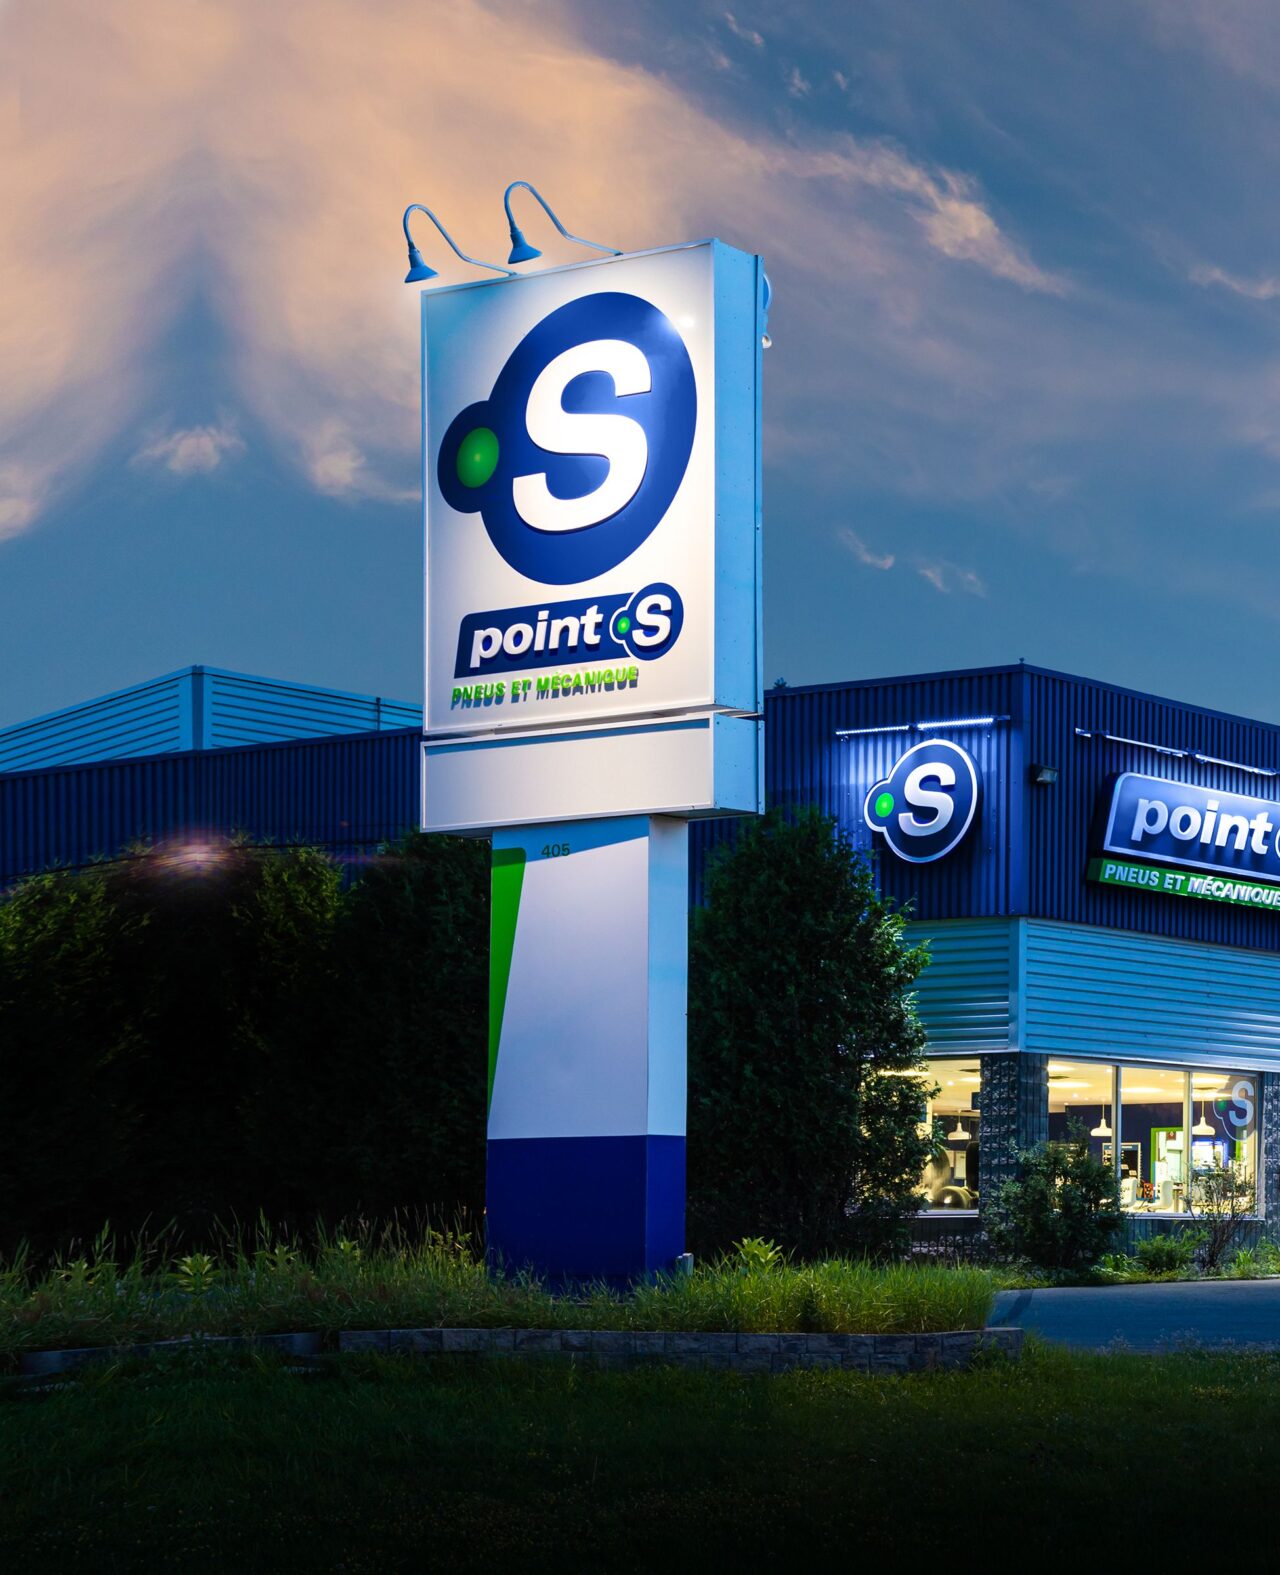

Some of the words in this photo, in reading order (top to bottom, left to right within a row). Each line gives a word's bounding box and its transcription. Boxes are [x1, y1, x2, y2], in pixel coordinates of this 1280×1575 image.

[512, 338, 652, 532] S
[469, 604, 604, 669] point
[631, 593, 673, 648] S
[451, 682, 506, 703] PNEUS
[511, 679, 531, 696] ET
[536, 664, 639, 693] MÉCANIQUE
[898, 761, 956, 837] S
[541, 843, 570, 858] 405
[1130, 798, 1274, 855] point
[1104, 863, 1159, 887] PNEUS
[1163, 873, 1185, 891] ET
[1228, 1080, 1254, 1127] S
